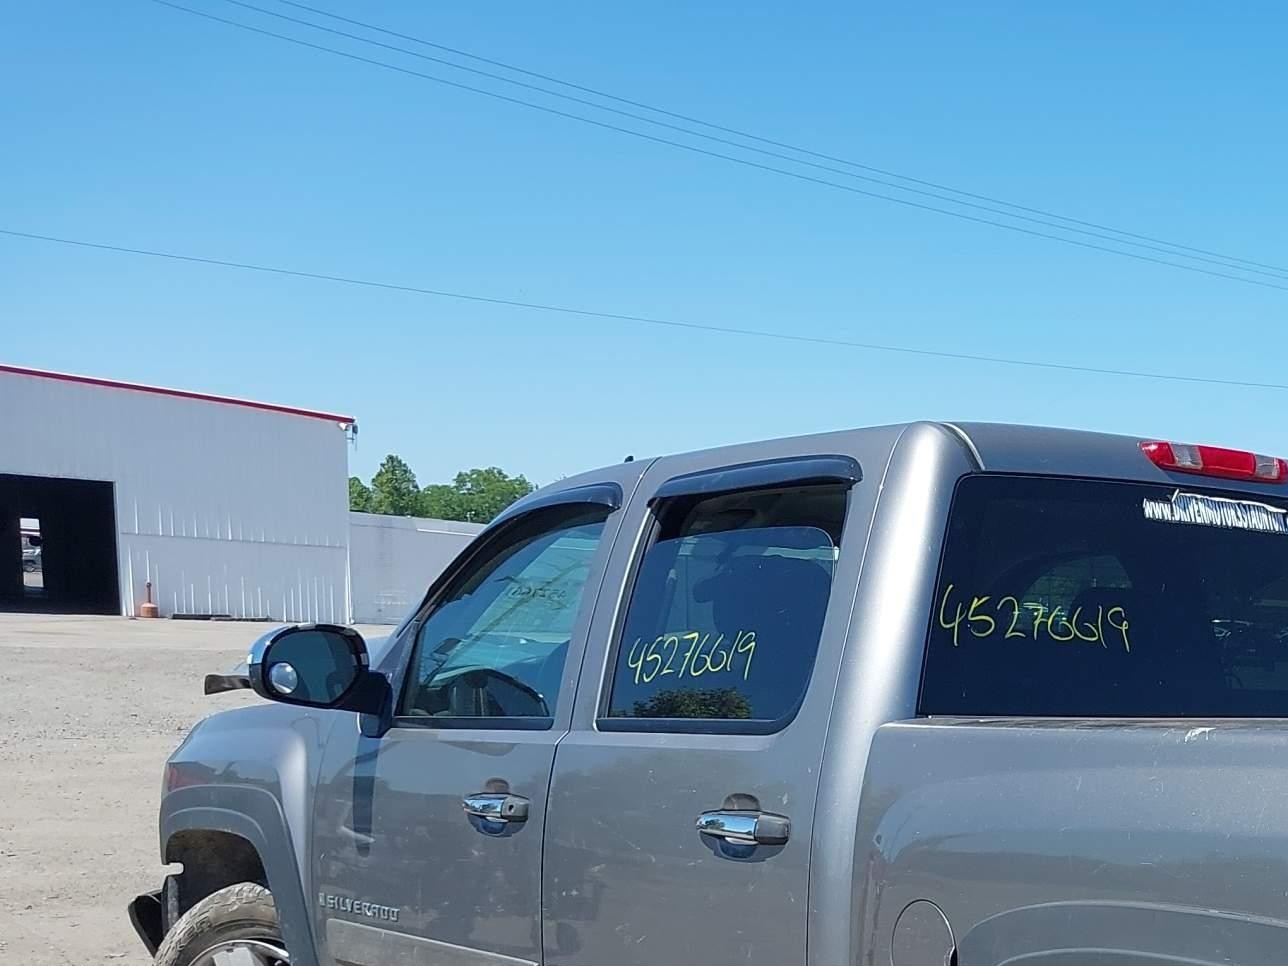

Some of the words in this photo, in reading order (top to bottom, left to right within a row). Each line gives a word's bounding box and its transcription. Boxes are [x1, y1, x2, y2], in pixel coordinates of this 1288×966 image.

[940, 585, 1130, 652] 45276619
[628, 631, 756, 684] 45276619
[325, 894, 400, 922] SILVERADO
